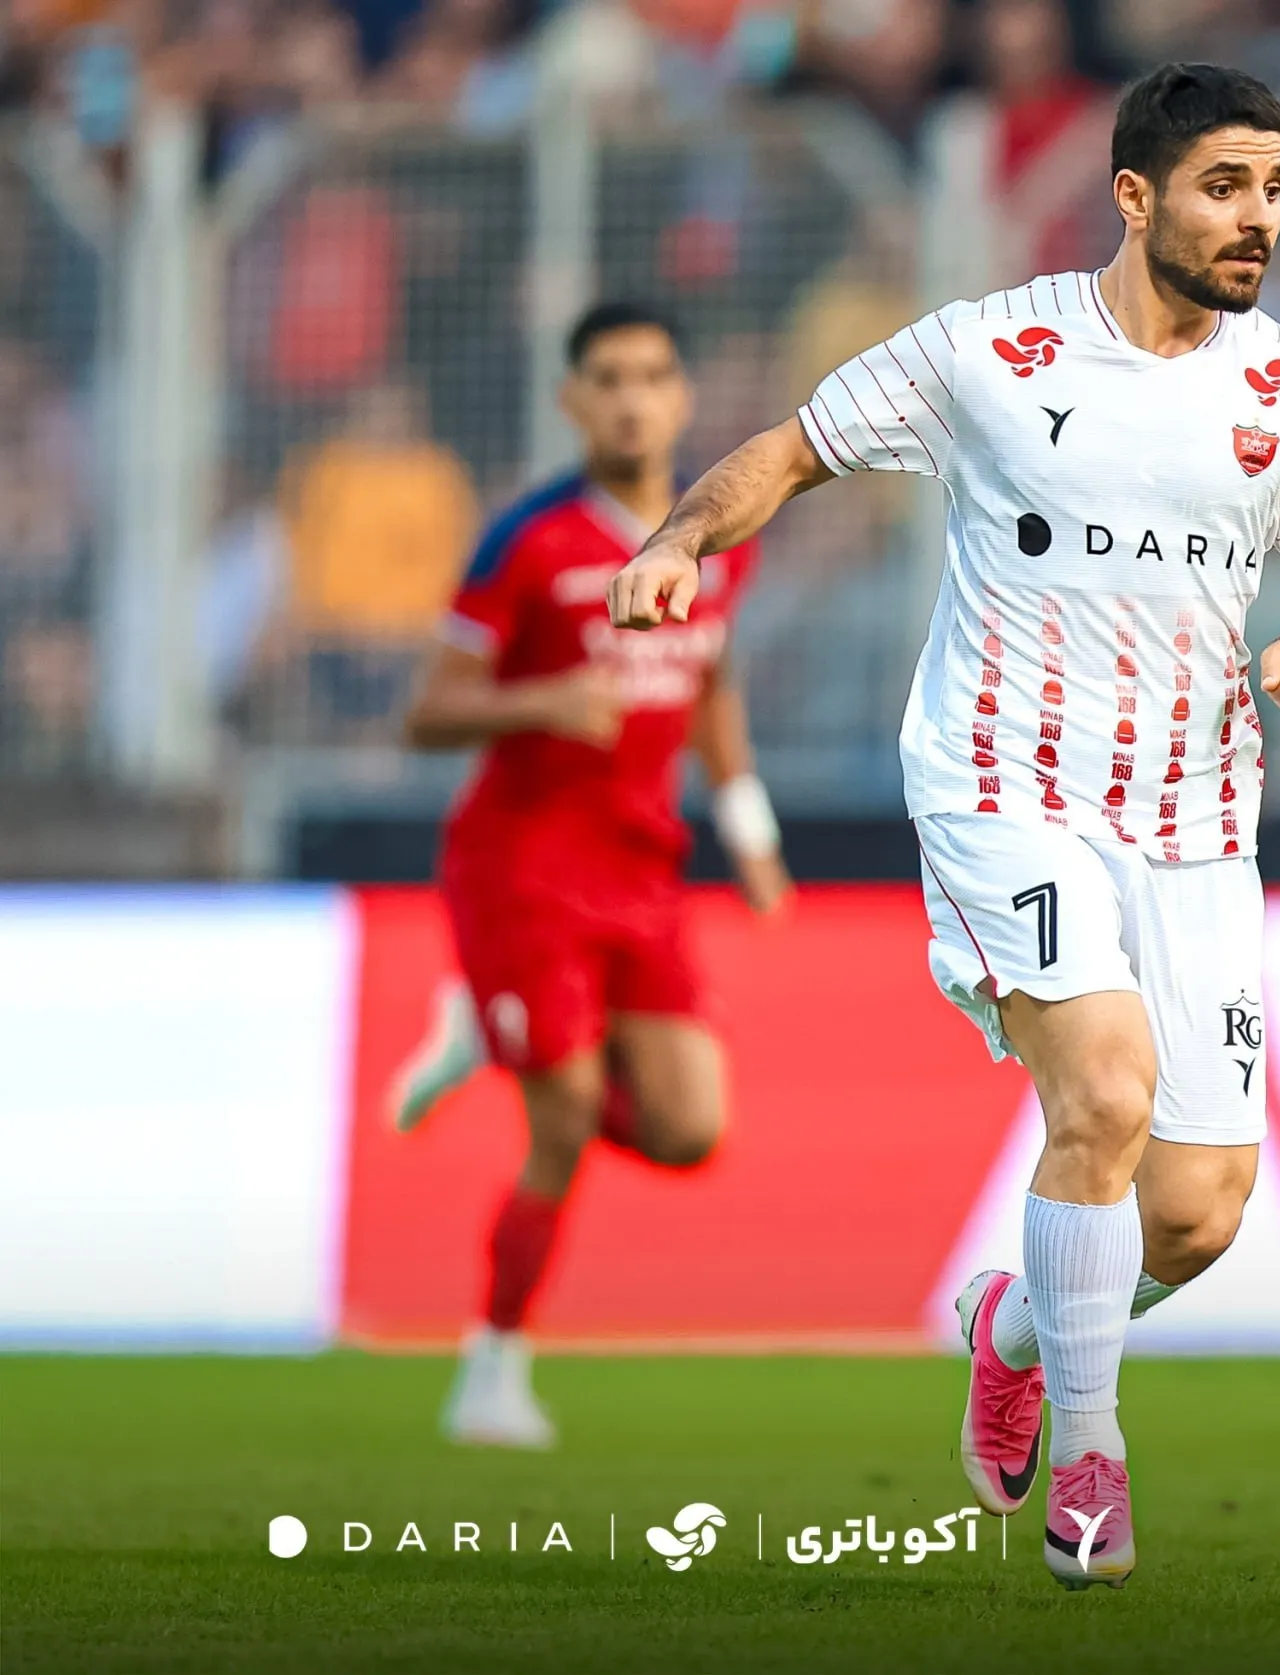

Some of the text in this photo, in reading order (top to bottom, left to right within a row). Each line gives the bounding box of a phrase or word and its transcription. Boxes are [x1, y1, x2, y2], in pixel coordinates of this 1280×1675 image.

[1085, 524, 1257, 573] DARIA
[981, 669, 1002, 688] 168
[1175, 674, 1192, 691] 168
[1117, 696, 1136, 714] 168
[1040, 709, 1064, 723] MINAB
[971, 721, 996, 735] MINAB
[1040, 721, 1062, 742] 168
[1169, 729, 1187, 739] MINAB
[972, 732, 994, 751] 168
[1169, 740, 1186, 758] 168
[1112, 751, 1135, 764] MINAB
[1111, 762, 1133, 781] 168
[978, 776, 1001, 794] 168
[1160, 791, 1179, 801] MINAB
[1101, 807, 1122, 821] MINAB
[1159, 802, 1177, 819] 168
[1044, 813, 1068, 826] MINAB
[1163, 840, 1181, 851] MINAB
[1221, 1007, 1262, 1049] RG
